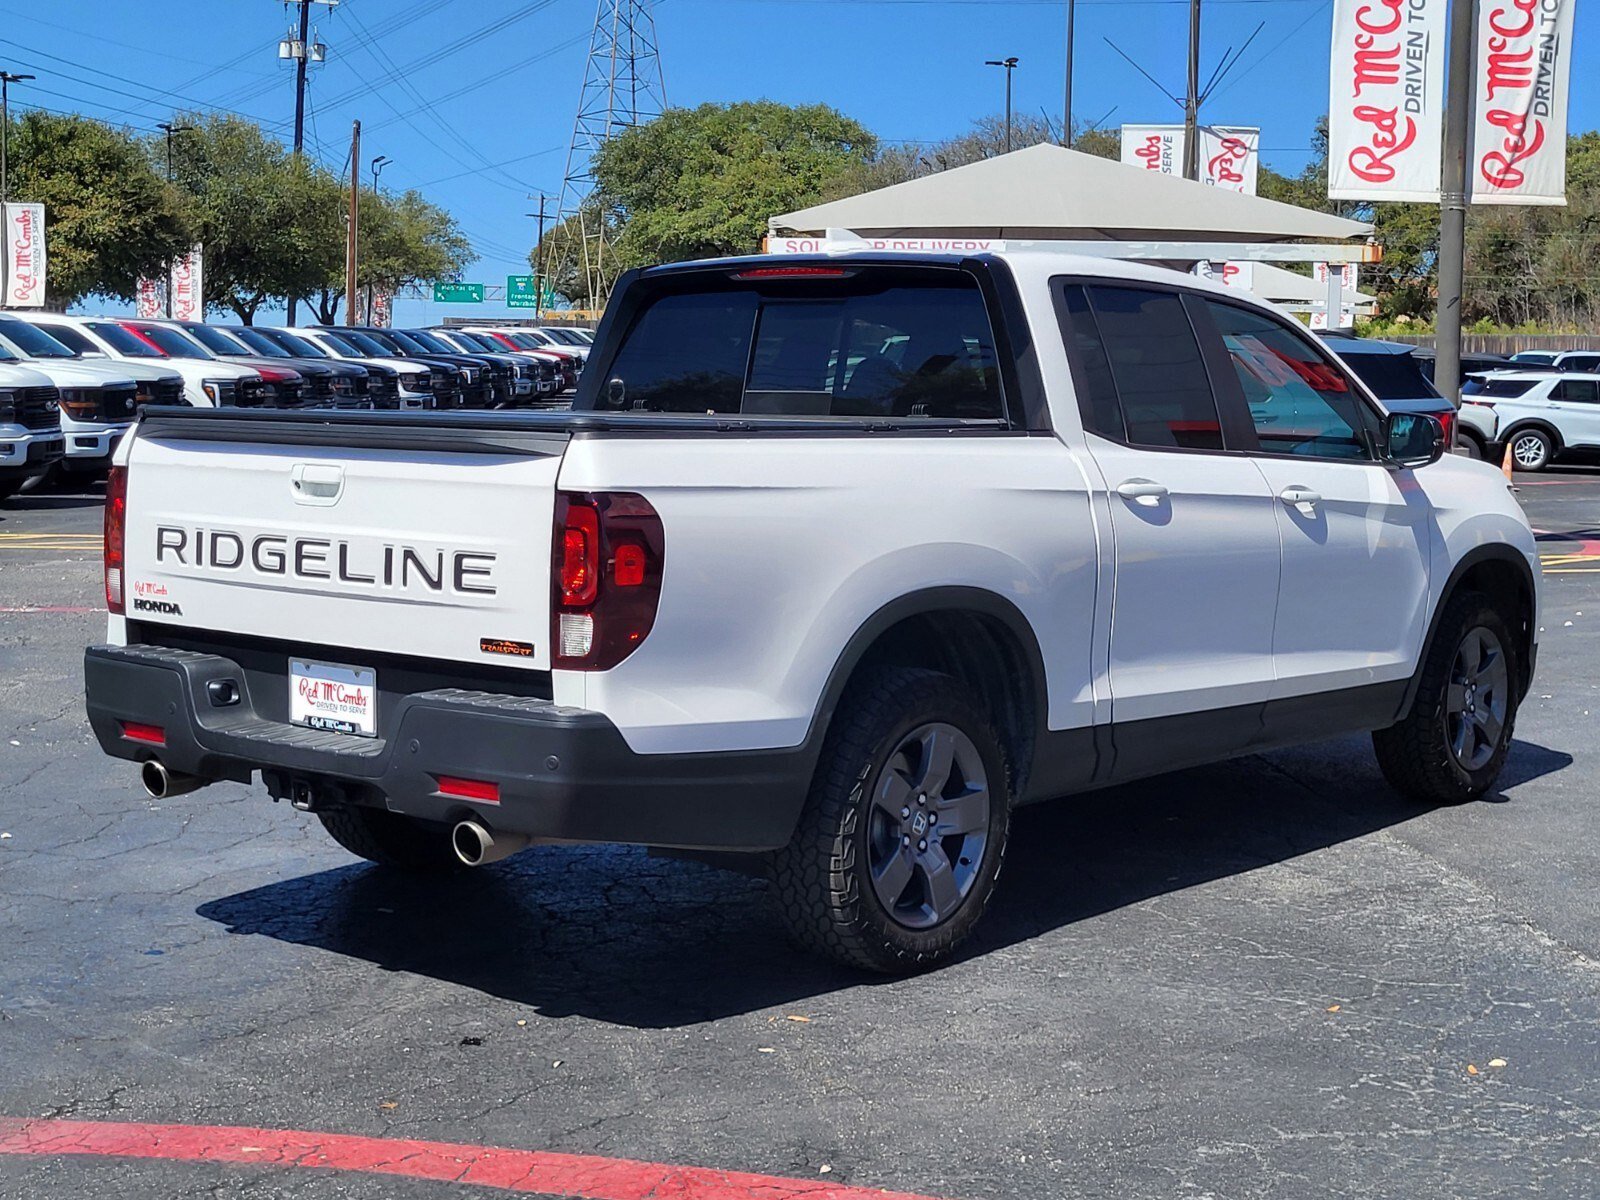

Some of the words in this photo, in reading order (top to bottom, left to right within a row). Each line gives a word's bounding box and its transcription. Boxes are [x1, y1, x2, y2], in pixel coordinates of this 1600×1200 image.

[1405, 31, 1424, 114] DRIVEN
[1534, 33, 1555, 117] DRIVEN
[1162, 135, 1173, 174] SERVE
[1208, 138, 1247, 183] Red
[1349, 106, 1417, 183] Red
[1481, 109, 1545, 189] Red
[15, 209, 31, 271] McCombs
[33, 236, 39, 245] TO
[893, 241, 990, 250] DELIVERY
[14, 270, 37, 300] Red
[156, 526, 498, 595] RIDGELINE
[133, 598, 183, 616] HONDA
[481, 643, 532, 656] TRAILSPORT
[299, 678, 318, 705] Red
[320, 681, 367, 707] McCombs
[316, 701, 338, 711] DRIVEN
[339, 704, 348, 712] TO
[348, 705, 367, 715] SERVE
